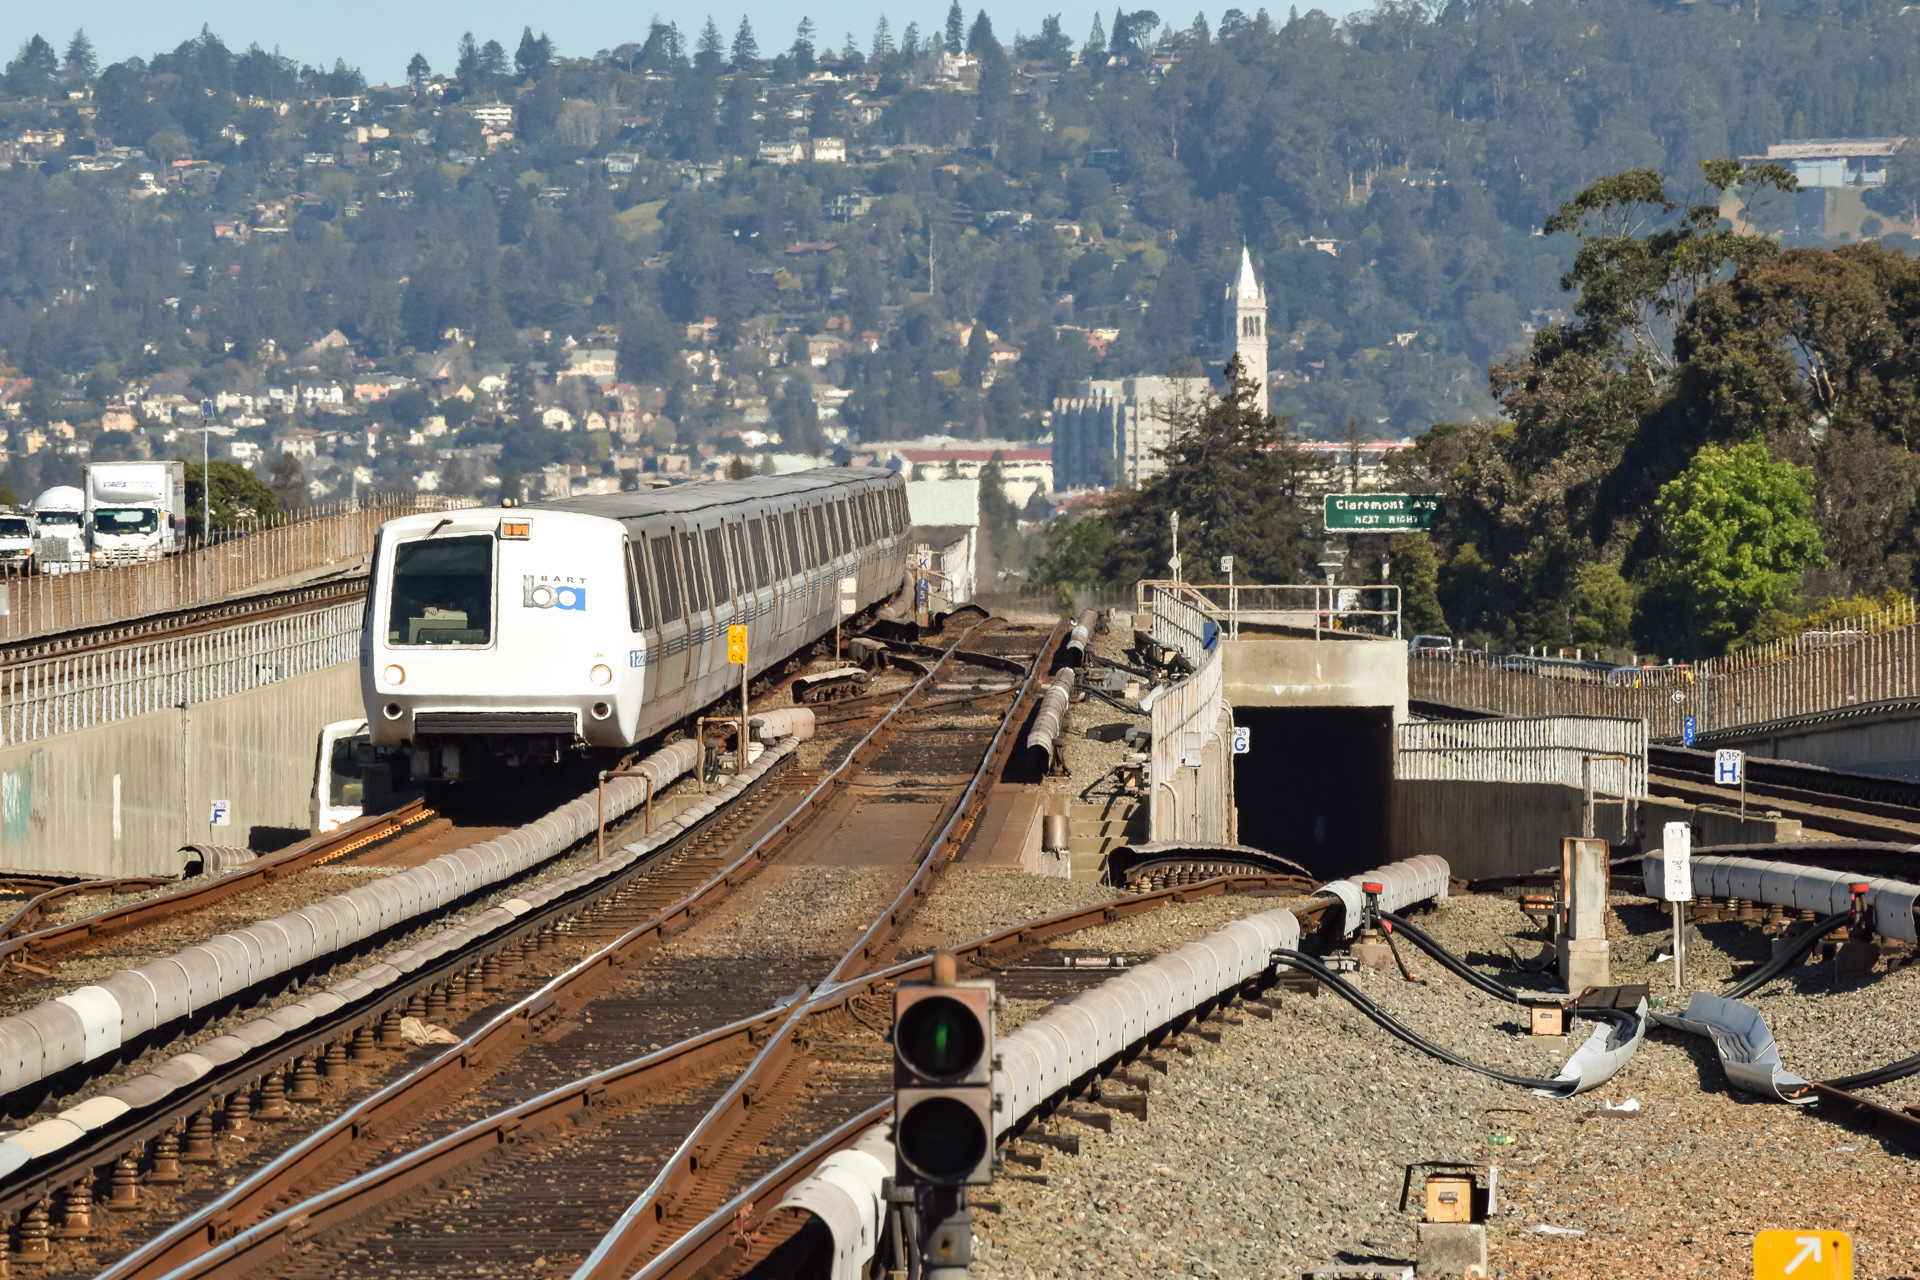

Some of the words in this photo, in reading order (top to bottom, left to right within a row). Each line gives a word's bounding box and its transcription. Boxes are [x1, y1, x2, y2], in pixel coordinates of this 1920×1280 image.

[1336, 500, 1404, 510] Claremont
[1413, 500, 1437, 510] Ave
[1354, 515, 1380, 524] NEXT
[919, 558, 928, 569] K
[541, 575, 586, 584] BART
[1234, 736, 1247, 752] G
[1719, 751, 1737, 761] K35
[1719, 762, 1737, 782] H
[213, 808, 226, 824] F
